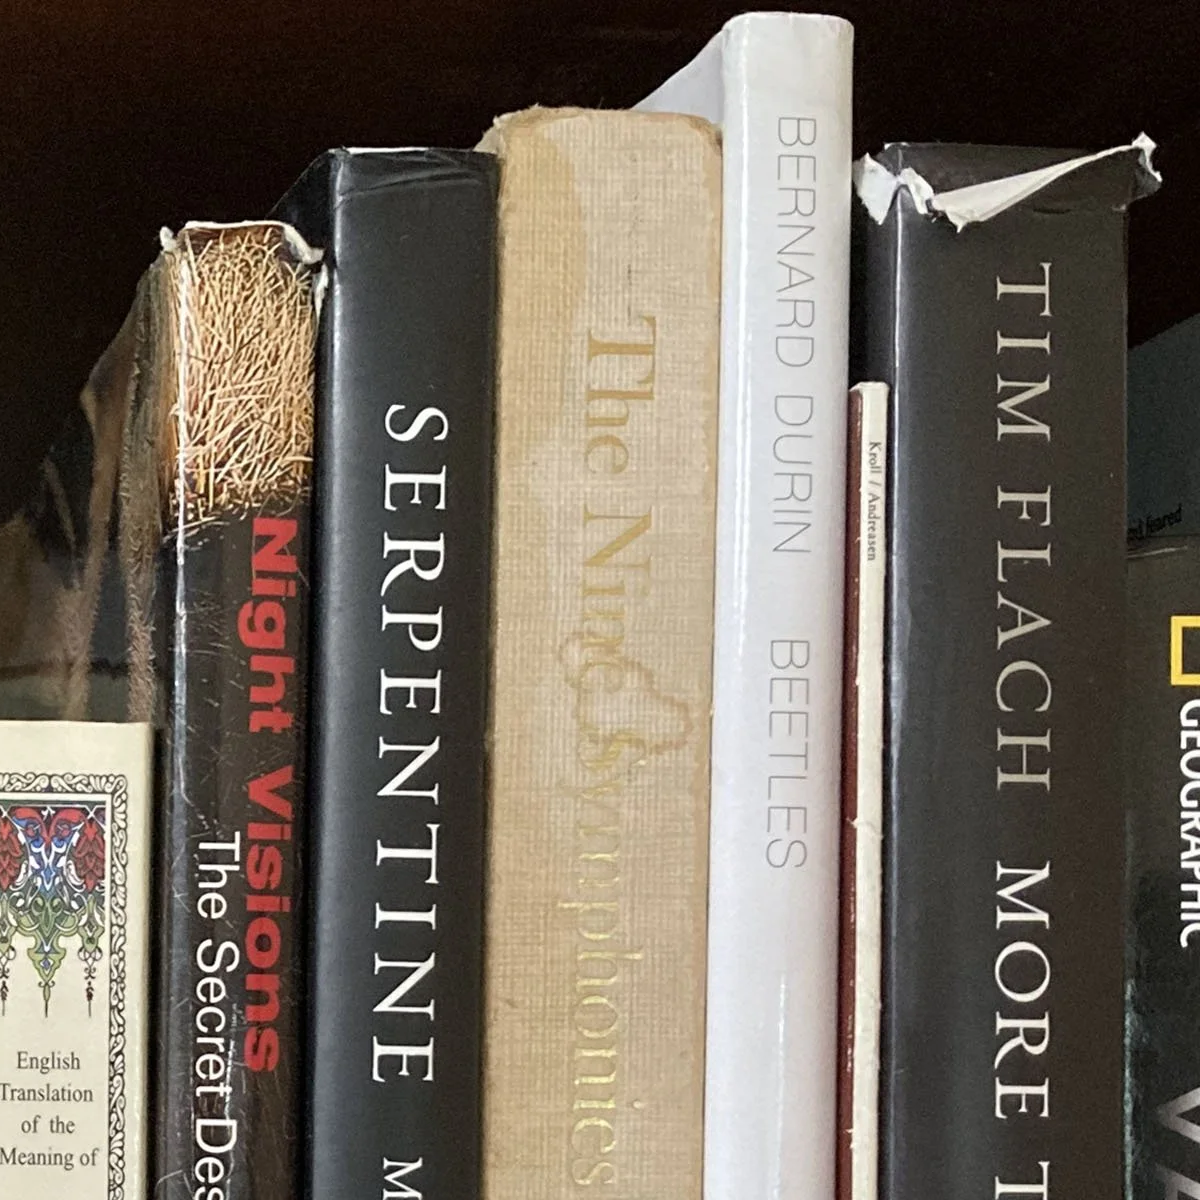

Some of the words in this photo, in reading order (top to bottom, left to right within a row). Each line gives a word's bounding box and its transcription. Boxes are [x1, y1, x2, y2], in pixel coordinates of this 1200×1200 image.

[774, 116, 816, 367] BERNARD
[585, 316, 657, 475] The
[997, 262, 1051, 442] TIM
[772, 394, 814, 554] DURIN
[867, 492, 881, 561] Andreasen
[868, 441, 882, 473] Kroll
[237, 517, 298, 733] Night
[582, 503, 654, 693] Nine
[996, 485, 1052, 792] FLACH
[371, 404, 449, 1083] SERPENTINE
[766, 639, 810, 870] BEETLES
[196, 831, 240, 919] The
[243, 764, 293, 1072] Visions
[557, 732, 649, 1186] Symphonies
[17, 1051, 81, 1074] English
[195, 939, 239, 1100] Secret
[994, 860, 1051, 1119] MORE
[0, 1147, 74, 1171] Meaning
[79, 1148, 99, 1167] of
[21, 1115, 41, 1134] of
[49, 1115, 75, 1134] the
